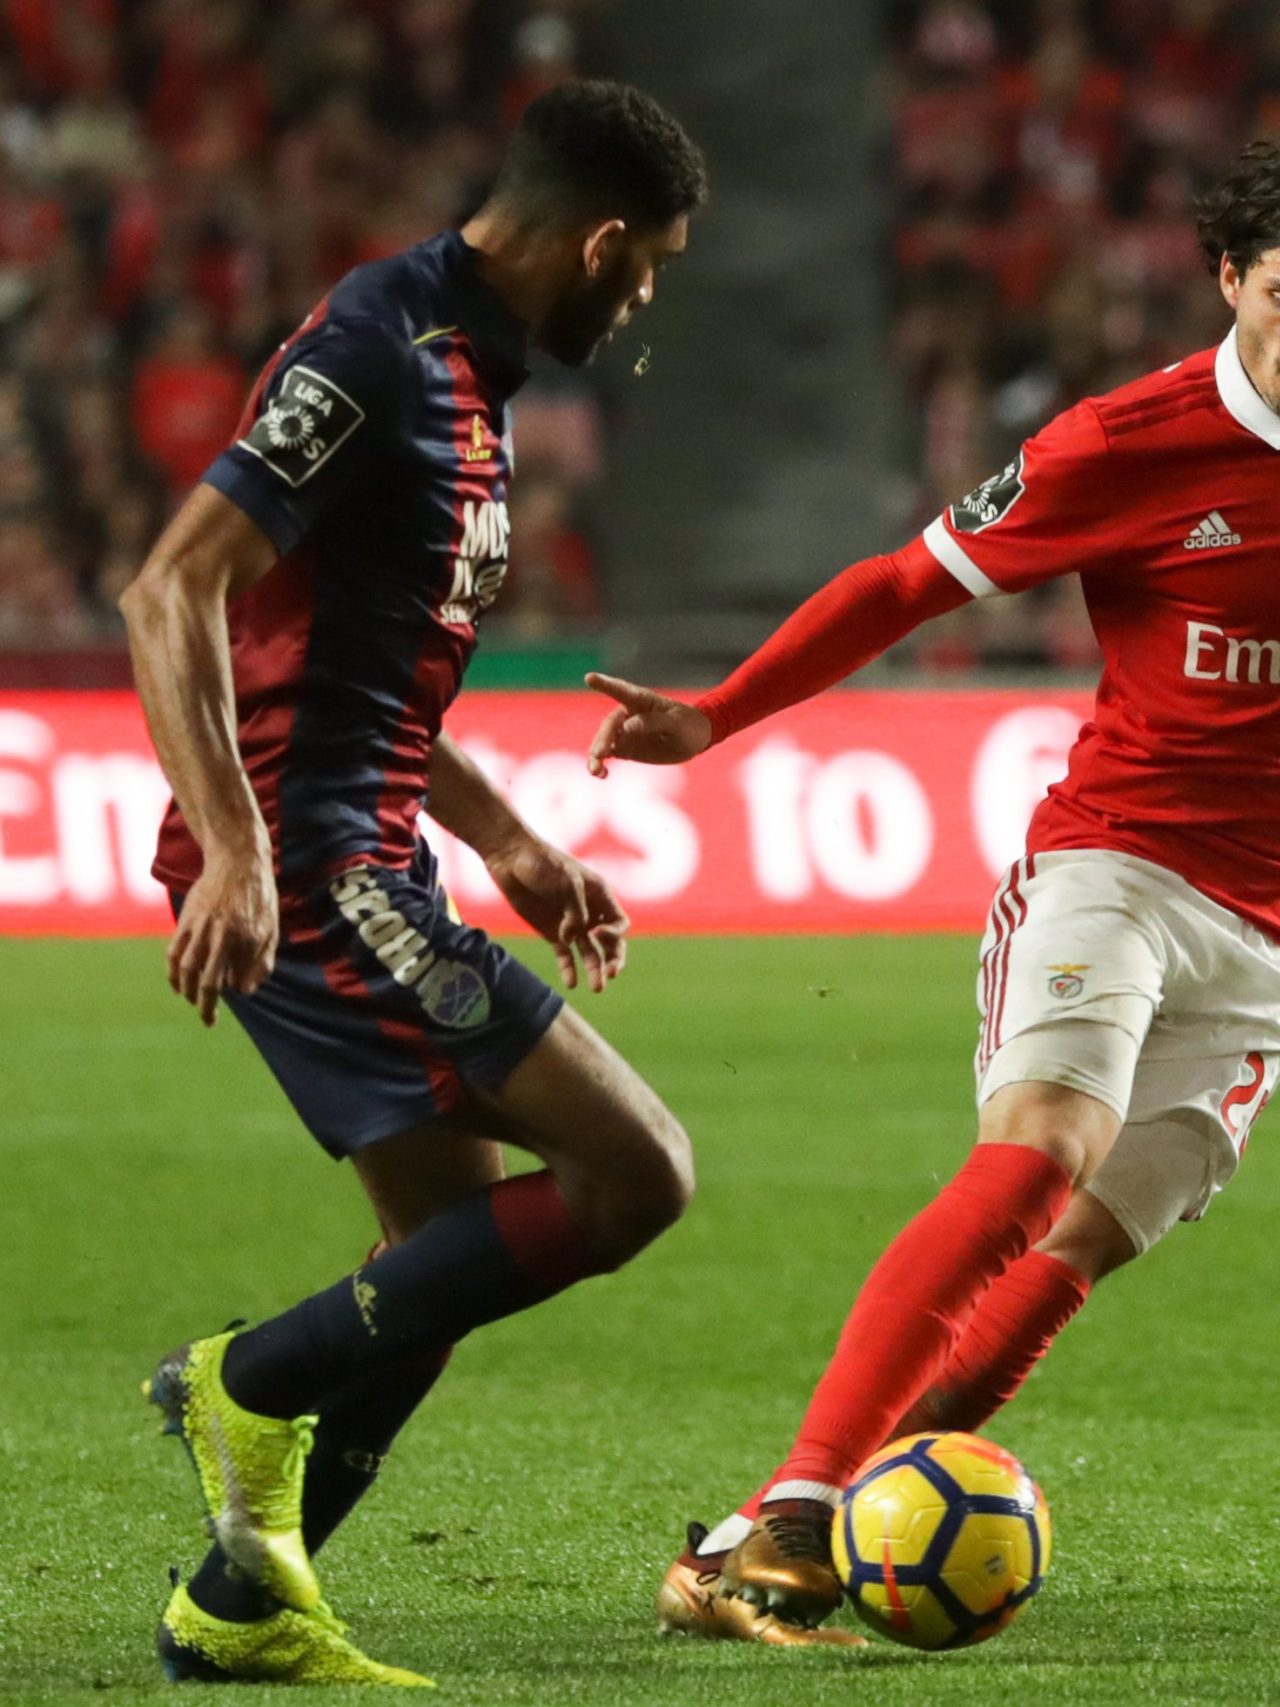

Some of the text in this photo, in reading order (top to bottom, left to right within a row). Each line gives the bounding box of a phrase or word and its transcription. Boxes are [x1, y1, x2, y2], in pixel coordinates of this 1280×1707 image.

[294, 381, 332, 417] LIGA
[1183, 532, 1242, 550] adidas
[738, 733, 934, 904] to
[1220, 1051, 1269, 1160] 2
